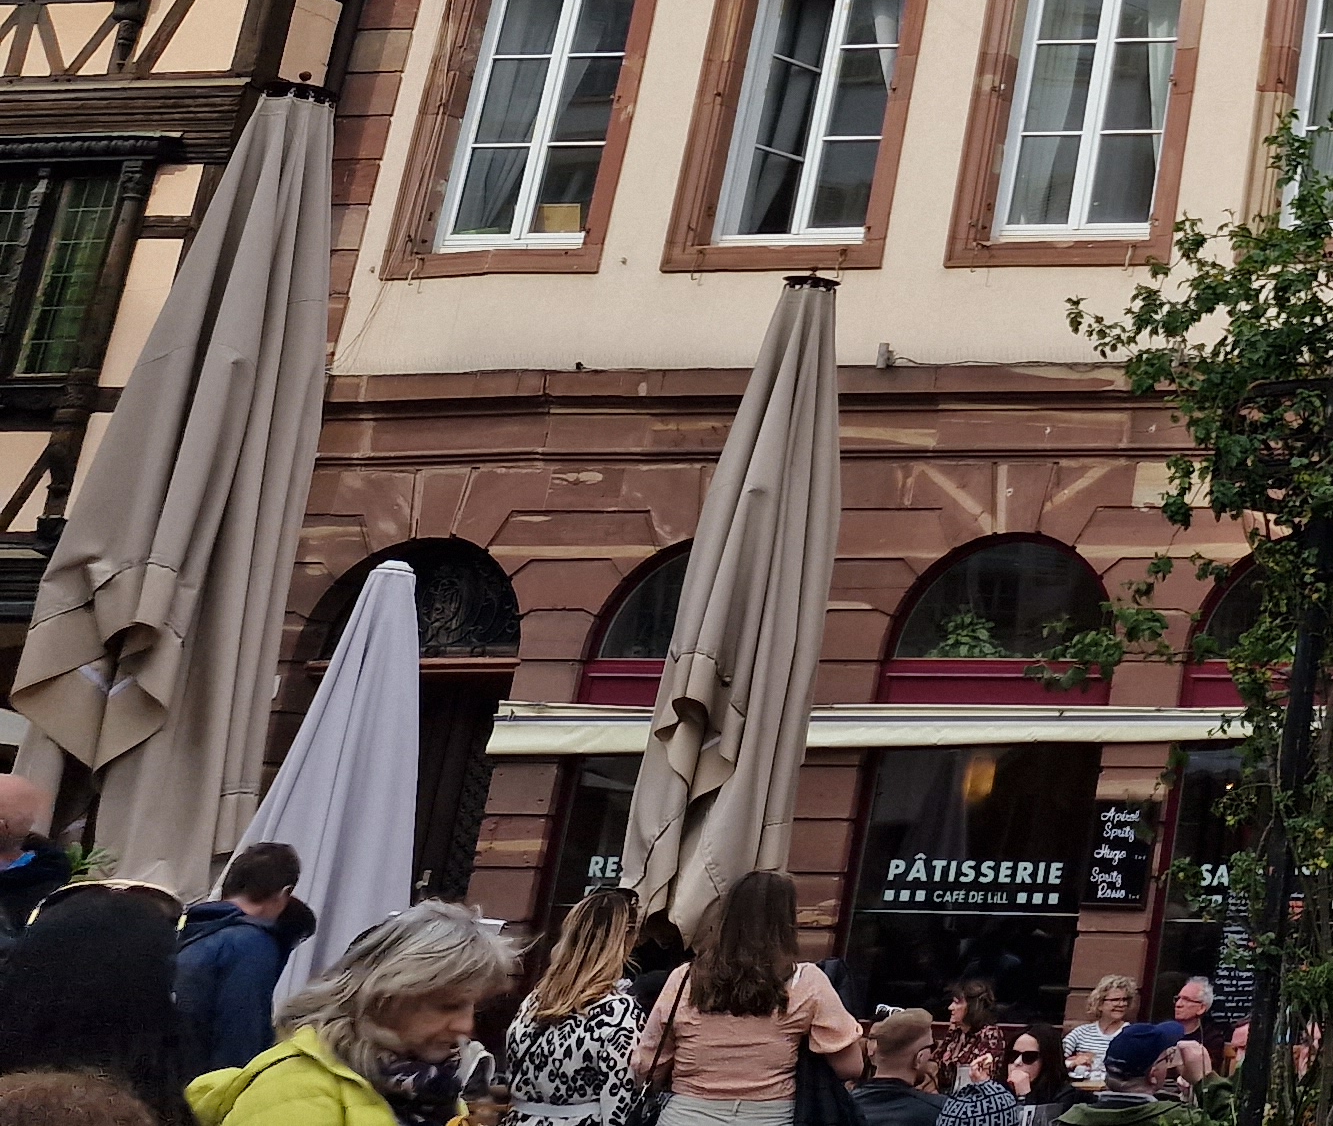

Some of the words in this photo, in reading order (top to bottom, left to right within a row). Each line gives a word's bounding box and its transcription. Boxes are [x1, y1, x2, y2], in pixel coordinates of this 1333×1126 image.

[1094, 844, 1127, 865] Hugo
[588, 856, 622, 878] RE
[887, 853, 1065, 885] PÂTISSERIE
[933, 889, 966, 903] CAFÉ
[968, 891, 985, 903] DE
